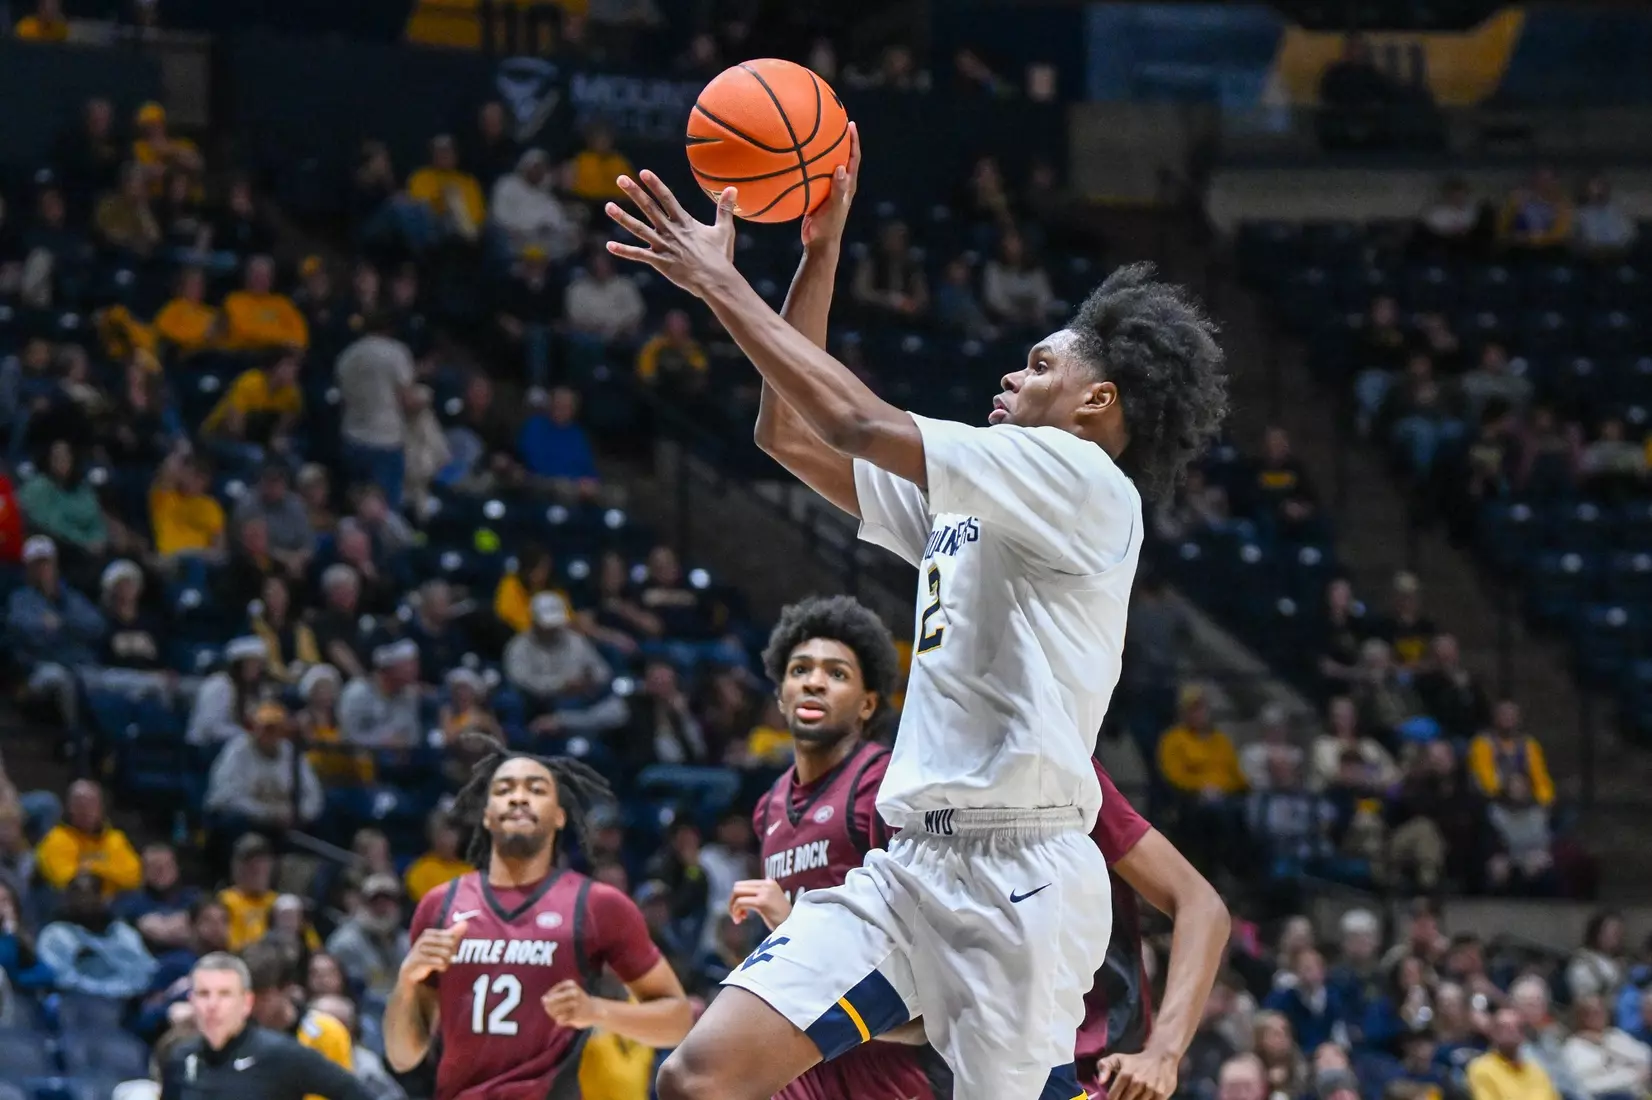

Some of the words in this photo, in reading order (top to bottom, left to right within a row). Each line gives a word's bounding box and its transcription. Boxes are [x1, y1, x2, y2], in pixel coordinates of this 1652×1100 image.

[916, 563, 945, 655] 2
[925, 808, 955, 836] WVU
[793, 839, 830, 874] ROCK
[503, 939, 559, 966] ROCK
[471, 973, 523, 1036] 12
